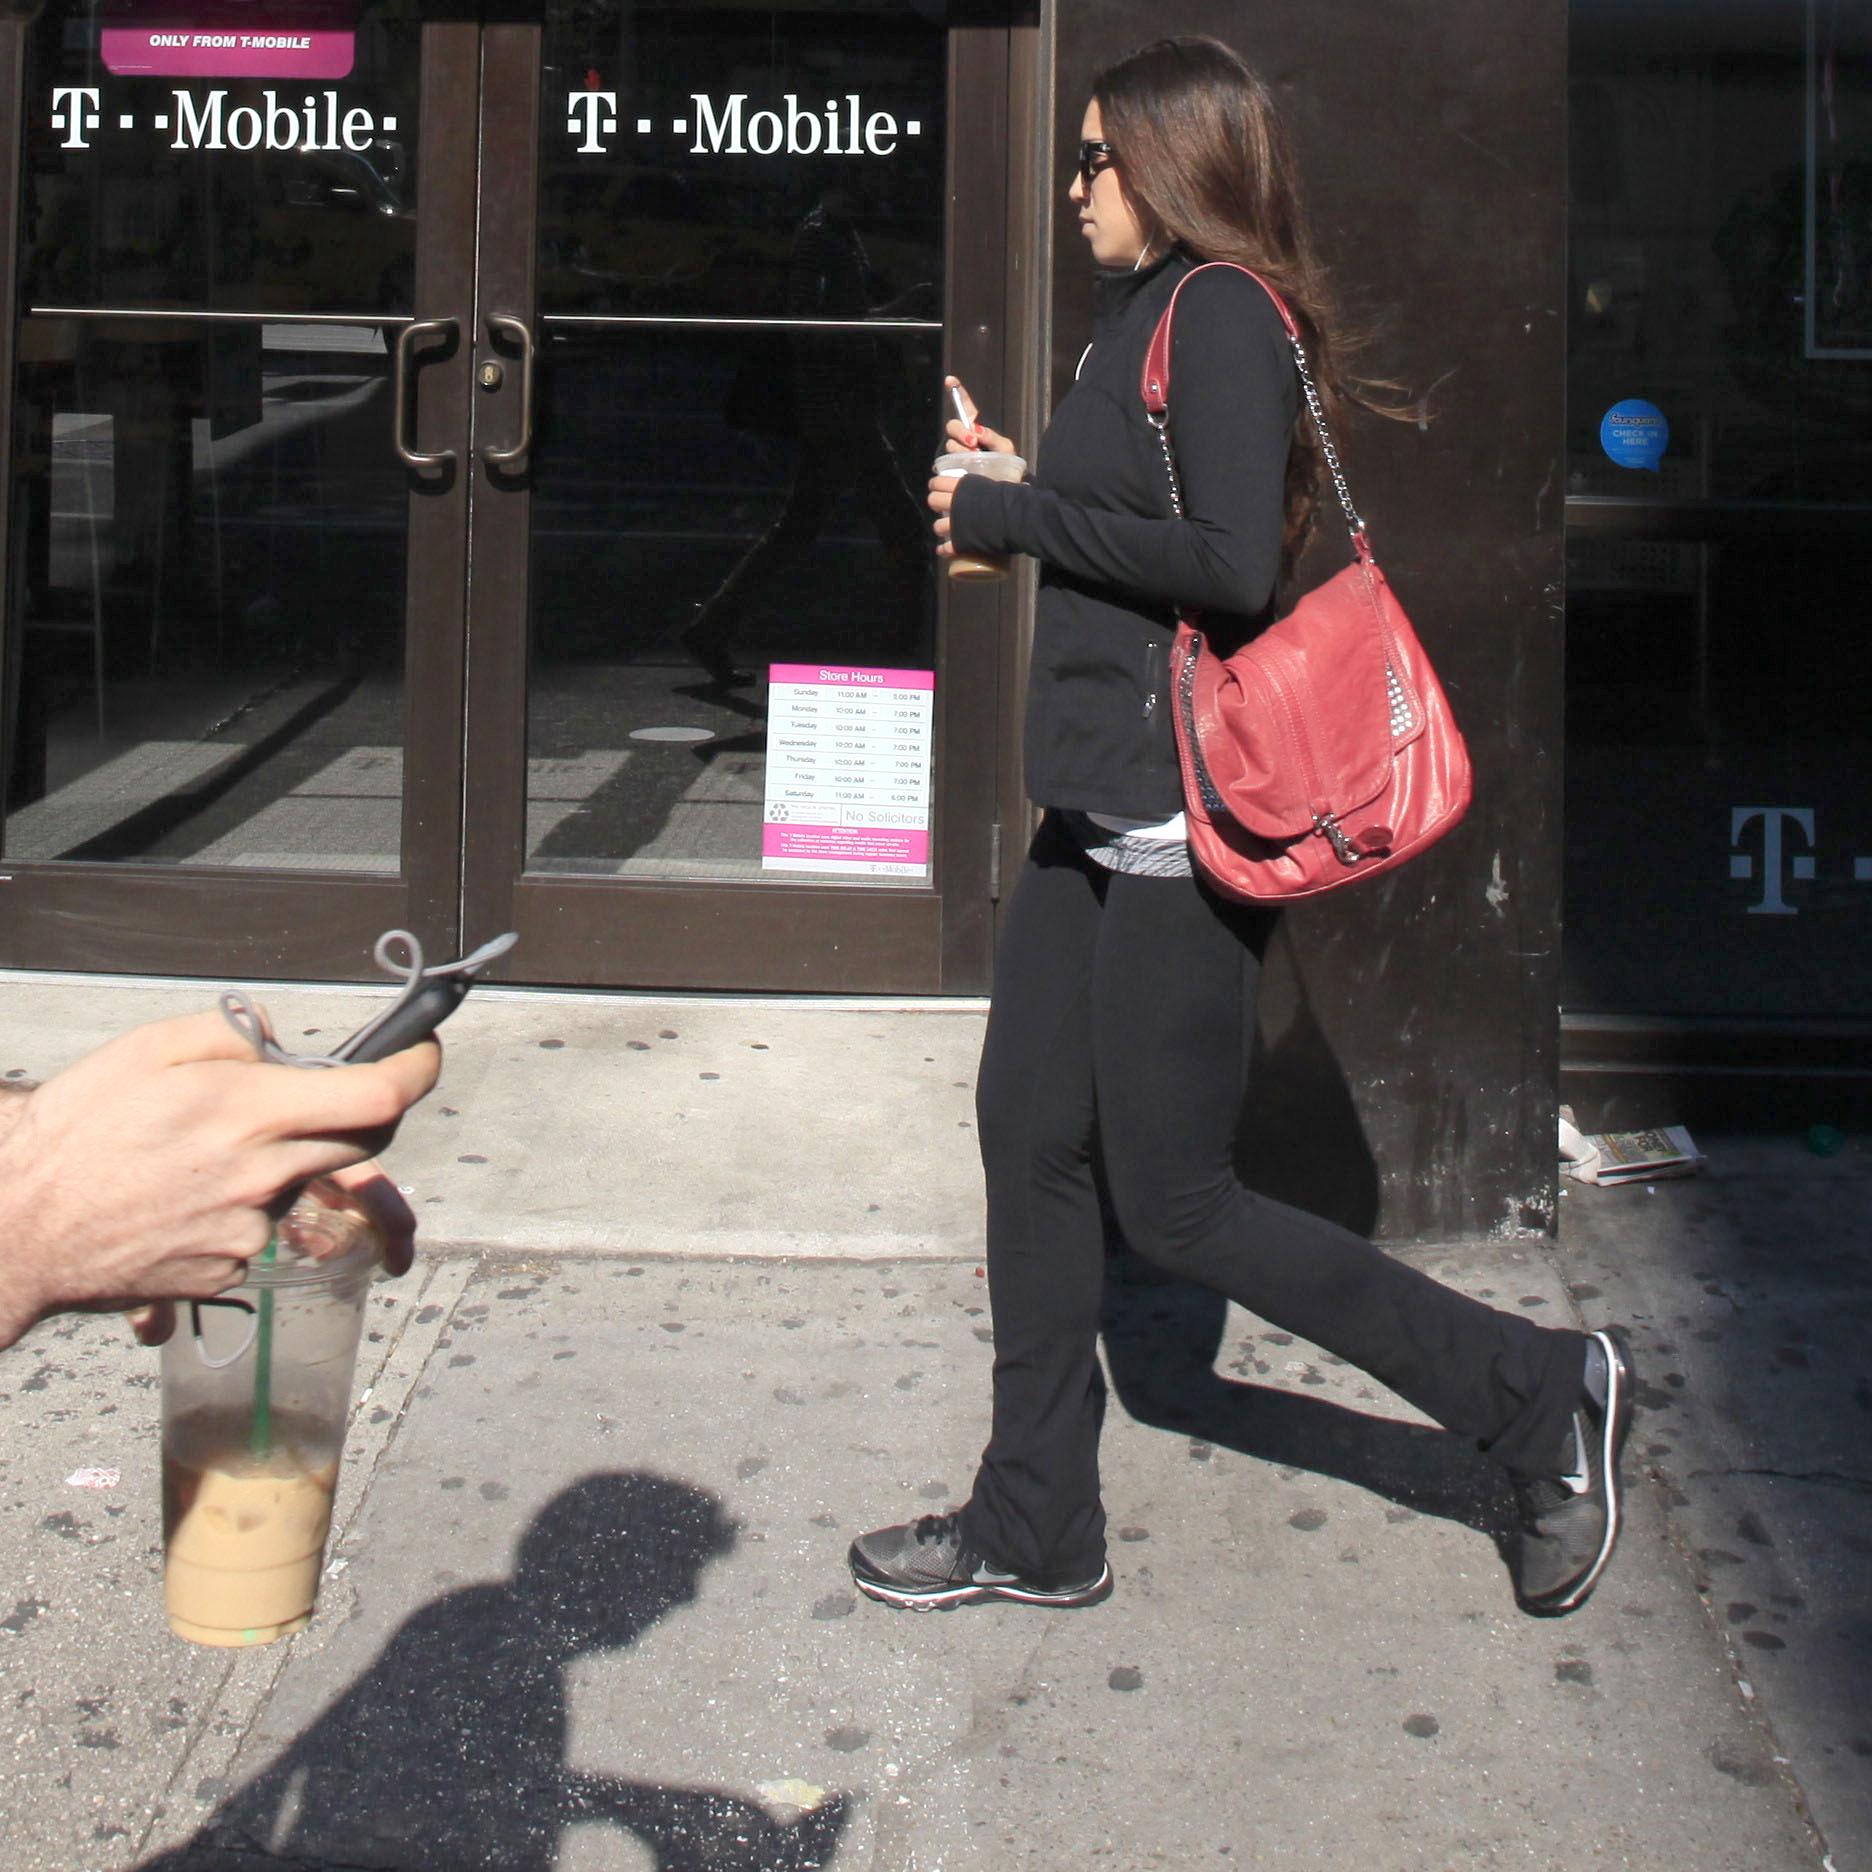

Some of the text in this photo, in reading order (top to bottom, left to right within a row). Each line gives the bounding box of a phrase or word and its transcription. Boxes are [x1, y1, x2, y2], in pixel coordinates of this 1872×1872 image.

[149, 34, 311, 49] ONLY FROM T-MOBILE
[819, 669, 884, 684] Store Hours
[846, 810, 864, 822] No
[868, 810, 925, 825] Solicitors
